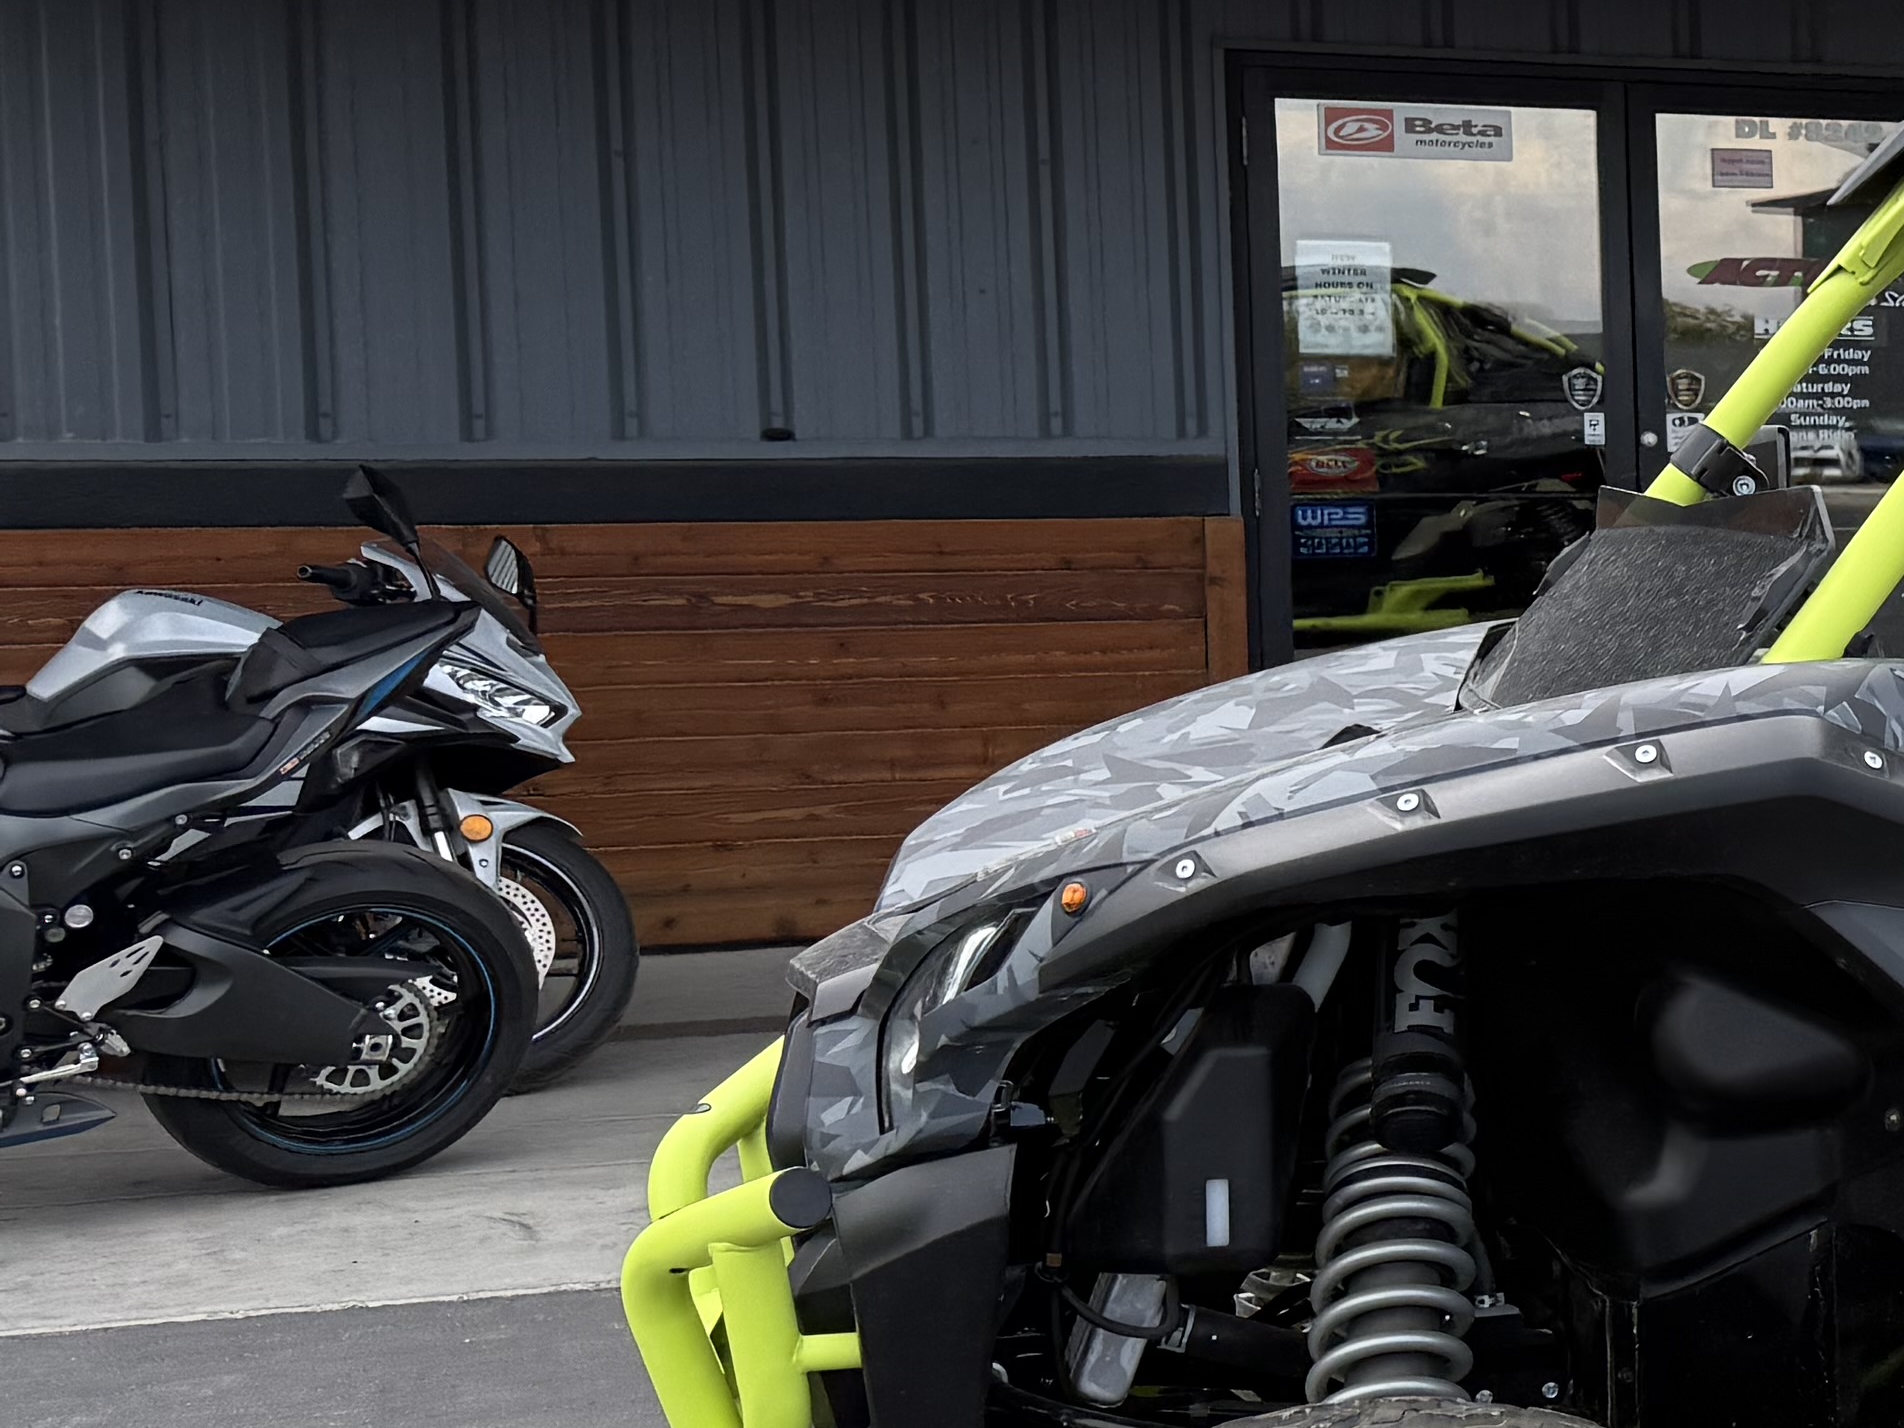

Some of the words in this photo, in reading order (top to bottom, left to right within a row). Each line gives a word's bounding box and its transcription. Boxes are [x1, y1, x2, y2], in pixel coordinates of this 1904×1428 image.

[1403, 116, 1503, 138] Beta
[1734, 118, 1777, 140] DL
[1415, 138, 1495, 150] motorcycles
[1792, 380, 1852, 395] aturday
[1296, 506, 1370, 526] WPS
